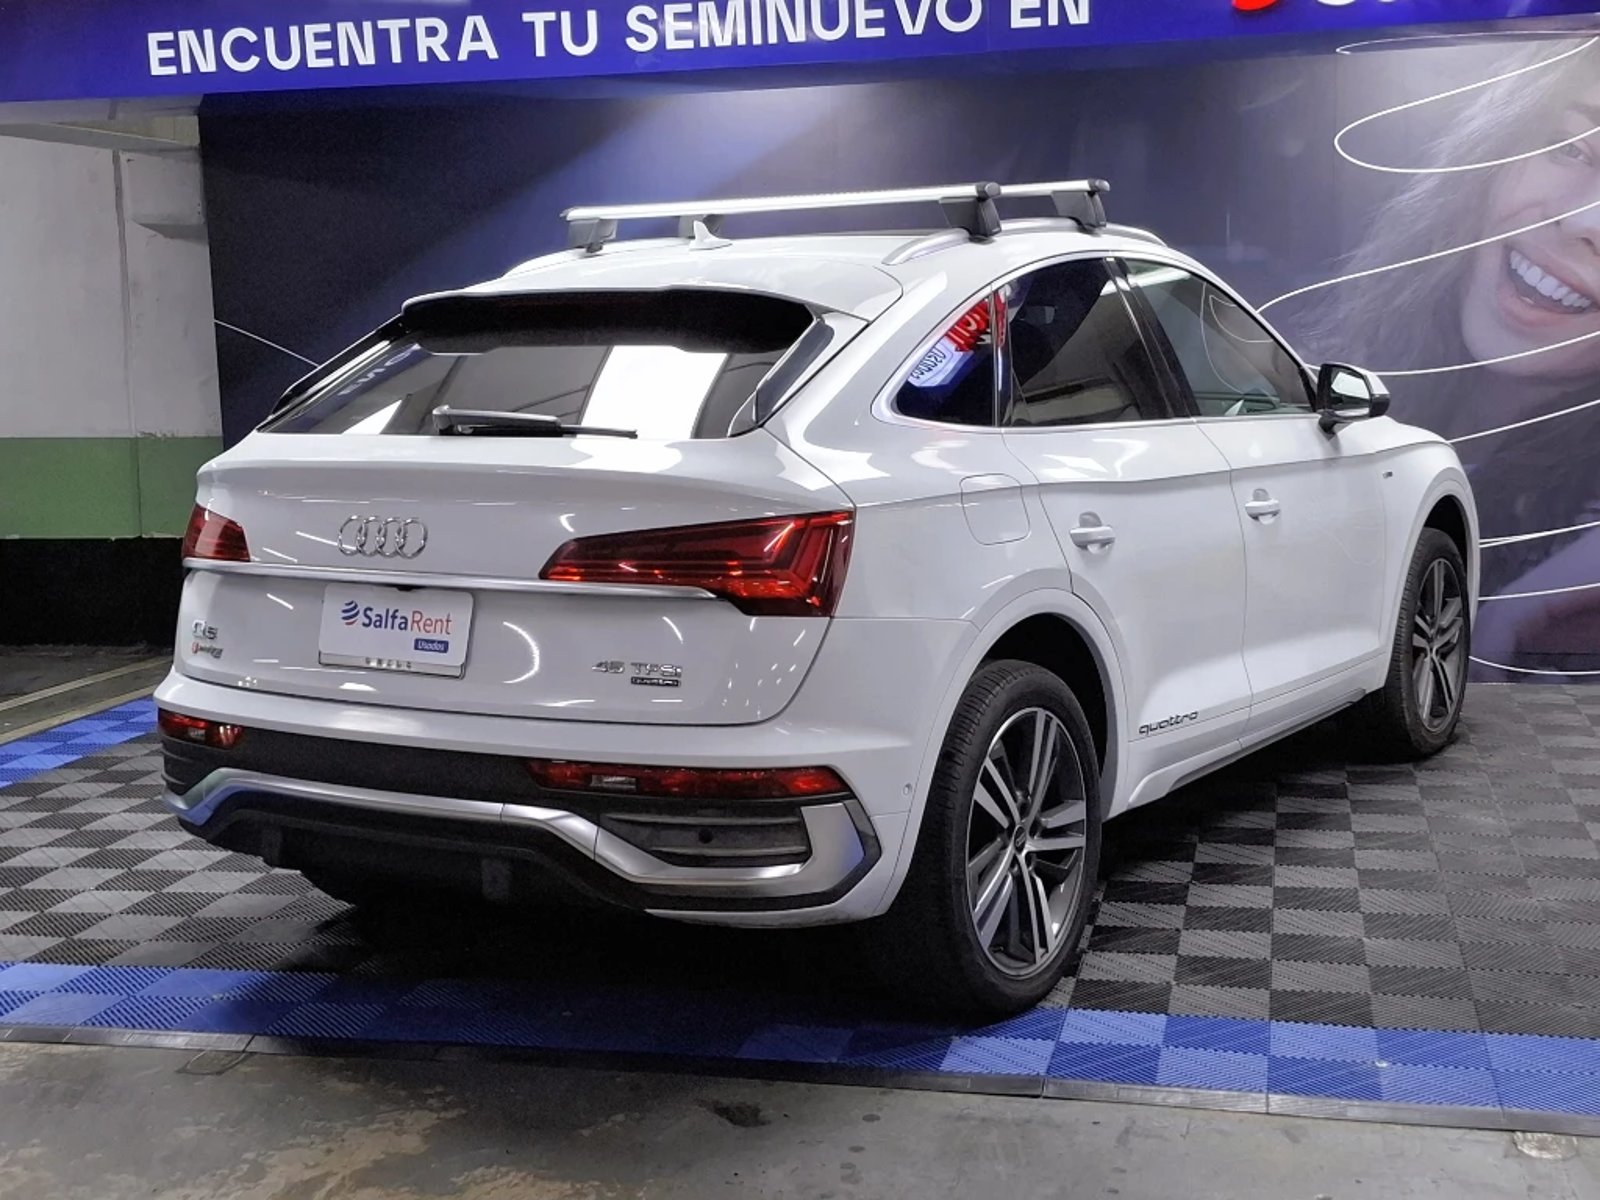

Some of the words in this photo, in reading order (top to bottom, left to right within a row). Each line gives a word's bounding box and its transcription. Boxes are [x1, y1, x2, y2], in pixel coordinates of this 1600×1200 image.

[147, 15, 497, 76] ENCUENTRA
[522, 9, 598, 57] TU
[625, 0, 982, 52] SEMINUEVO
[1010, 0, 1090, 29] EN
[1139, 711, 1198, 735] quattro
